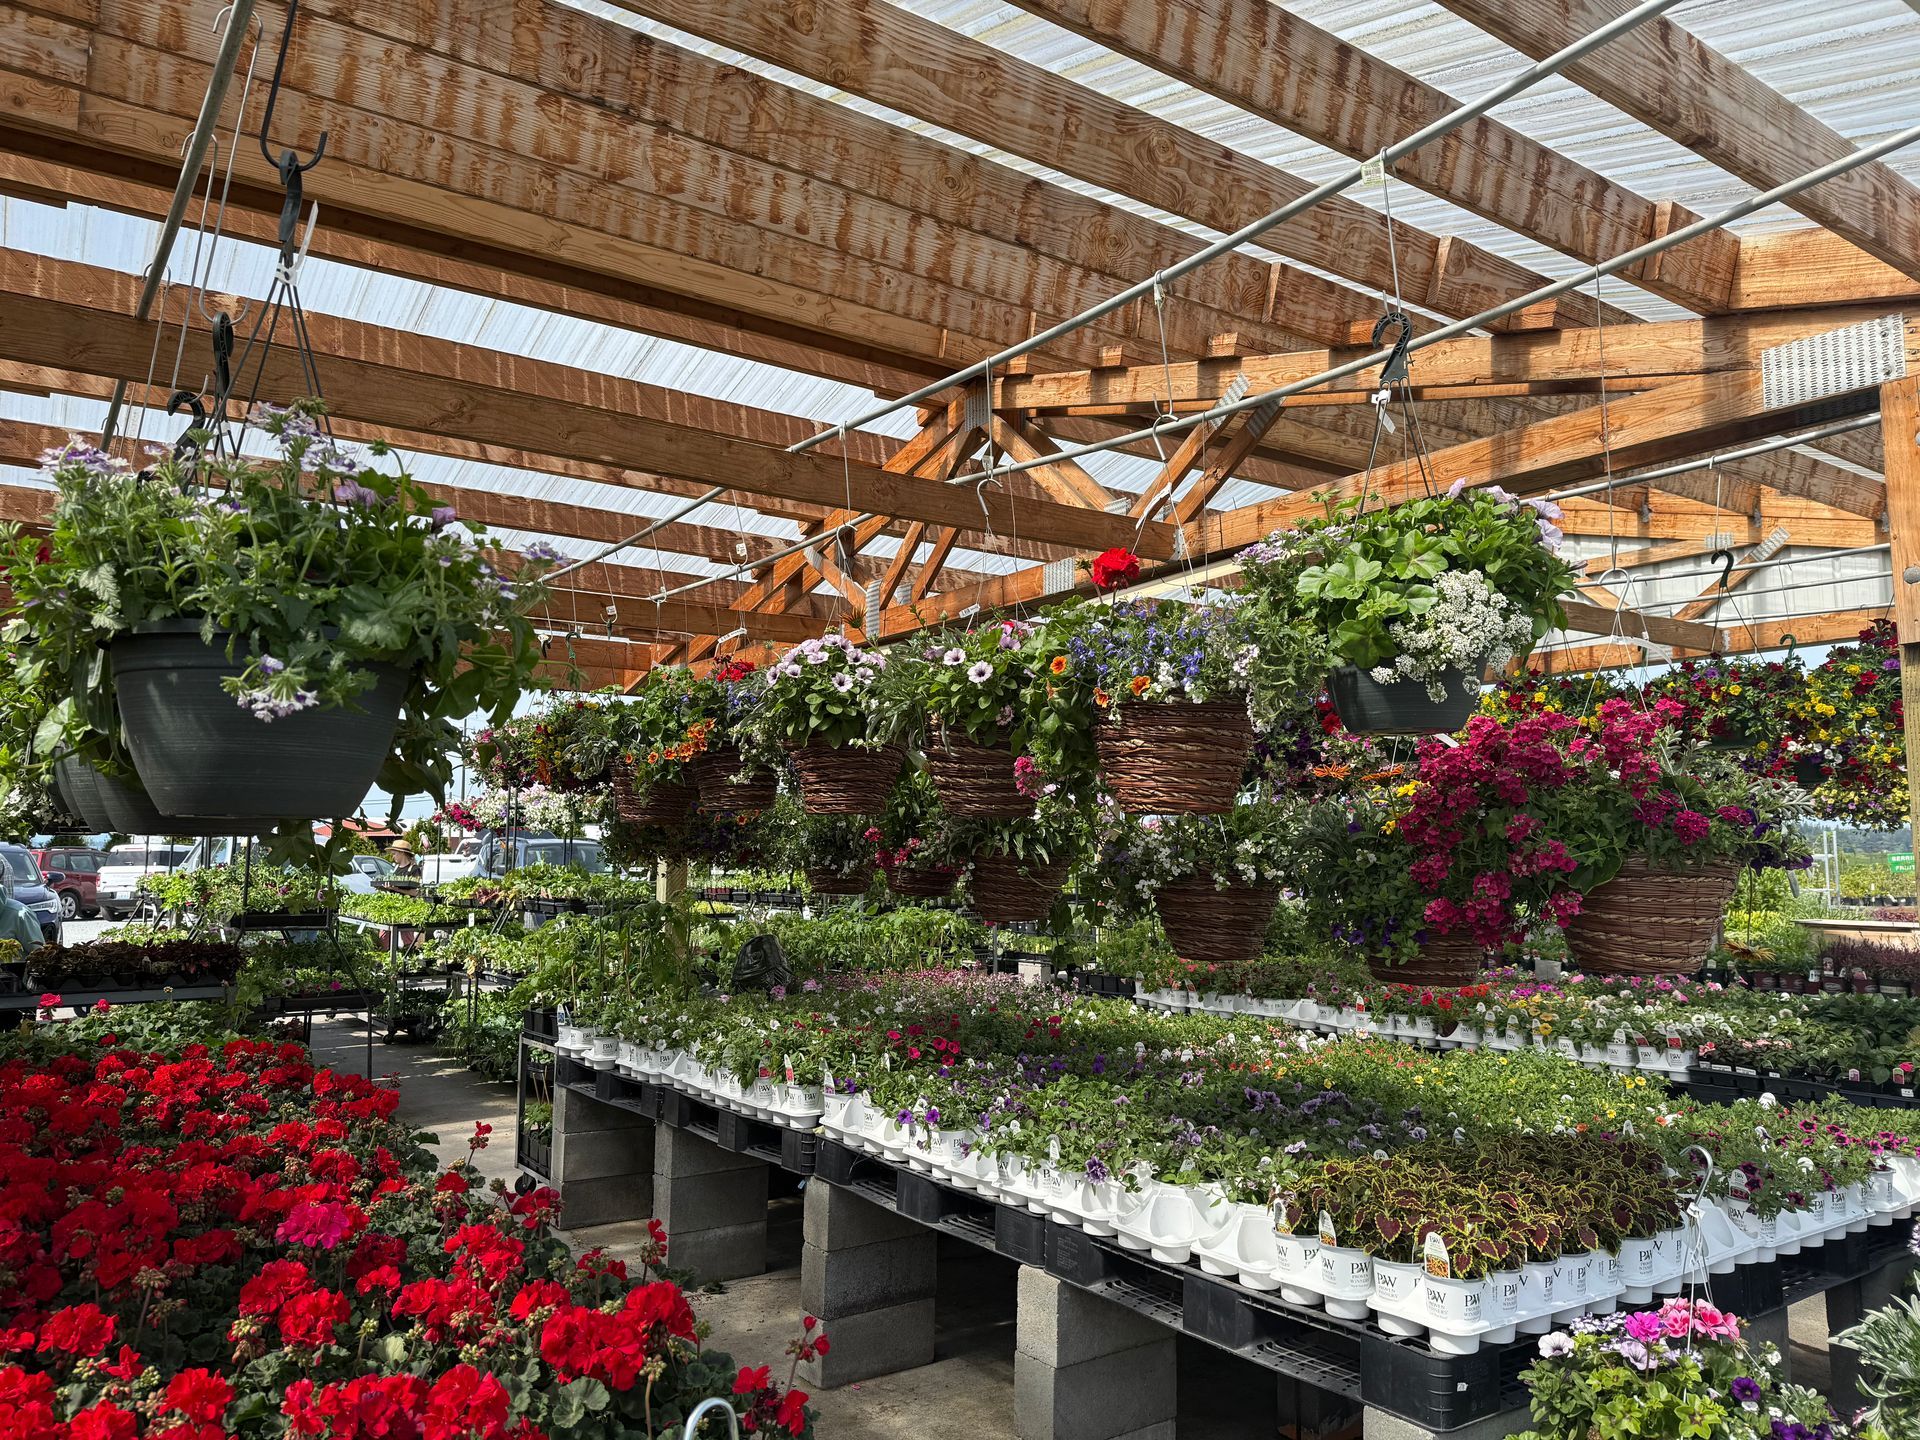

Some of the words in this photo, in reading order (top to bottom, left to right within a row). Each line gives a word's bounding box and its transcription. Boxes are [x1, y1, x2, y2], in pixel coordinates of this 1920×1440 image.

[1351, 1261, 1370, 1275] PW
[1377, 1273, 1397, 1288] PW
[1426, 1287, 1446, 1304] PW
[1464, 1291, 1481, 1307] PW
